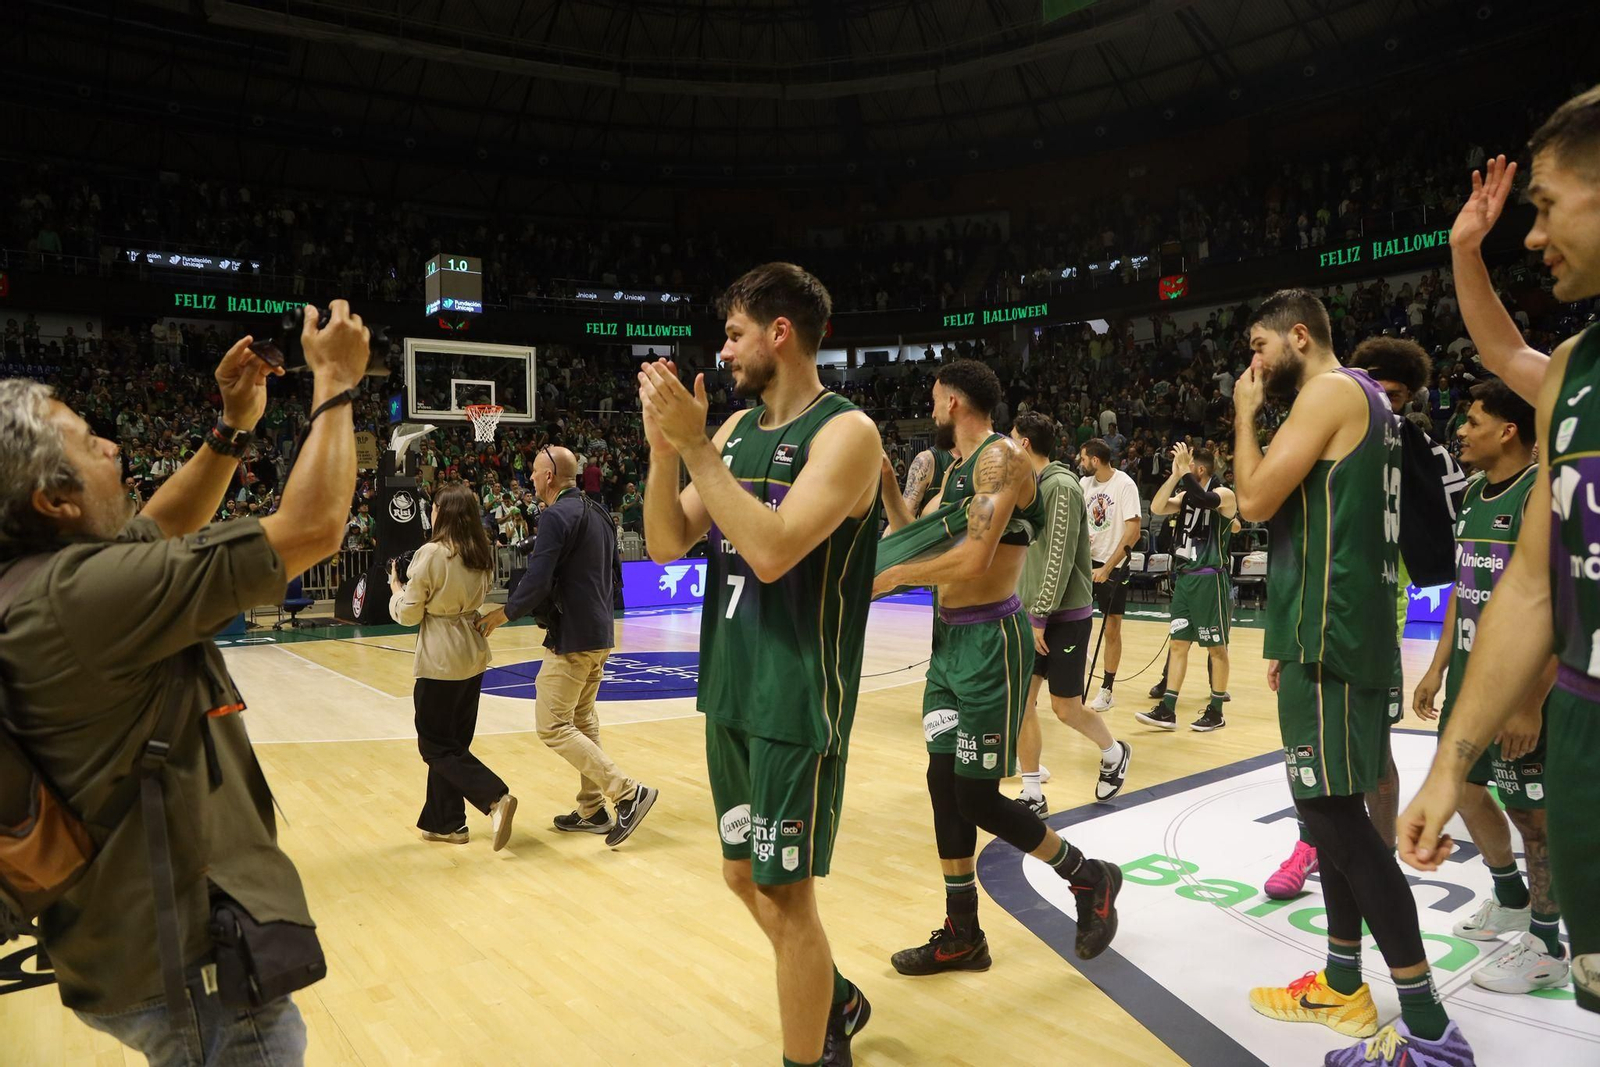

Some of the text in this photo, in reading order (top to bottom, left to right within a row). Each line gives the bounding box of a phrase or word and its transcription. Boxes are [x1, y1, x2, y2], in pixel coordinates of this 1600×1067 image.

[1320, 229, 1452, 267] FELIZ HALLOWE
[448, 259, 468, 271] 1.0
[174, 293, 216, 309] FELIZ
[624, 294, 646, 302] Unicaja
[943, 303, 1048, 327] FELIZ HALLOWEEN
[586, 323, 692, 337] FELIZ HALLOWEEN
[1461, 552, 1504, 573] Unicaja
[725, 574, 746, 619] 7
[1457, 617, 1476, 652] 13
[1495, 774, 1521, 795] laga
[783, 826, 798, 834] acb
